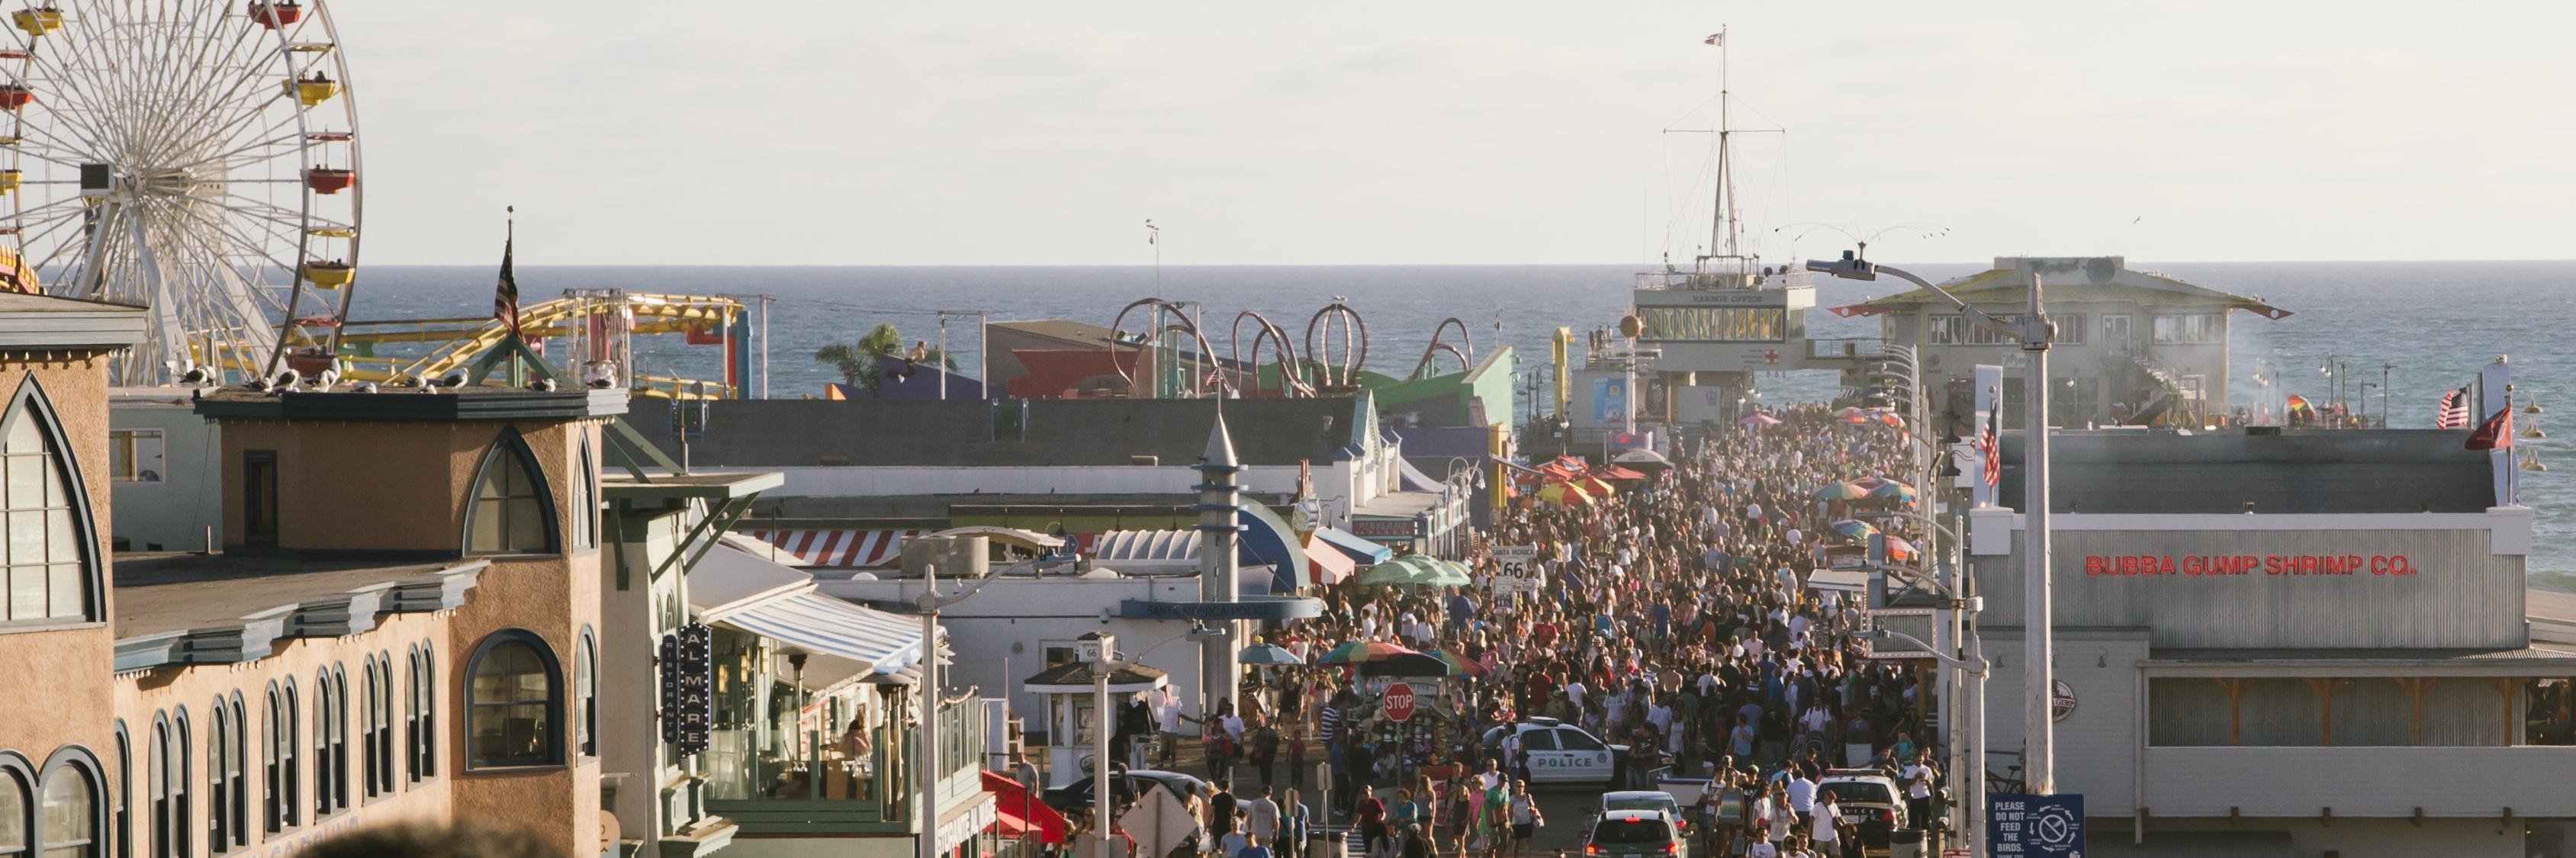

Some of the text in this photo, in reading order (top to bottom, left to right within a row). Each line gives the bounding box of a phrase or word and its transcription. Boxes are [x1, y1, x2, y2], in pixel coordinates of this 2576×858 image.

[1503, 561, 1523, 579] 66
[2086, 555, 2176, 576] BUBBA
[2182, 555, 2259, 576] GUMP
[2265, 554, 2363, 576] SHRIMP
[1147, 605, 1271, 616] SANTA MONICA POLICE
[666, 642, 674, 737] RISTORANTE
[686, 634, 702, 742] AL MARE
[1386, 695, 1413, 709] STOP
[1538, 758, 1592, 767] POLICE
[1995, 802, 2024, 811] PLEASE
[1996, 812, 2006, 821] DO
[2008, 812, 2024, 821] NOT
[2000, 823, 2021, 831] FEED
[2003, 833, 2018, 841] THE
[1997, 843, 2024, 852] BIRDS.
